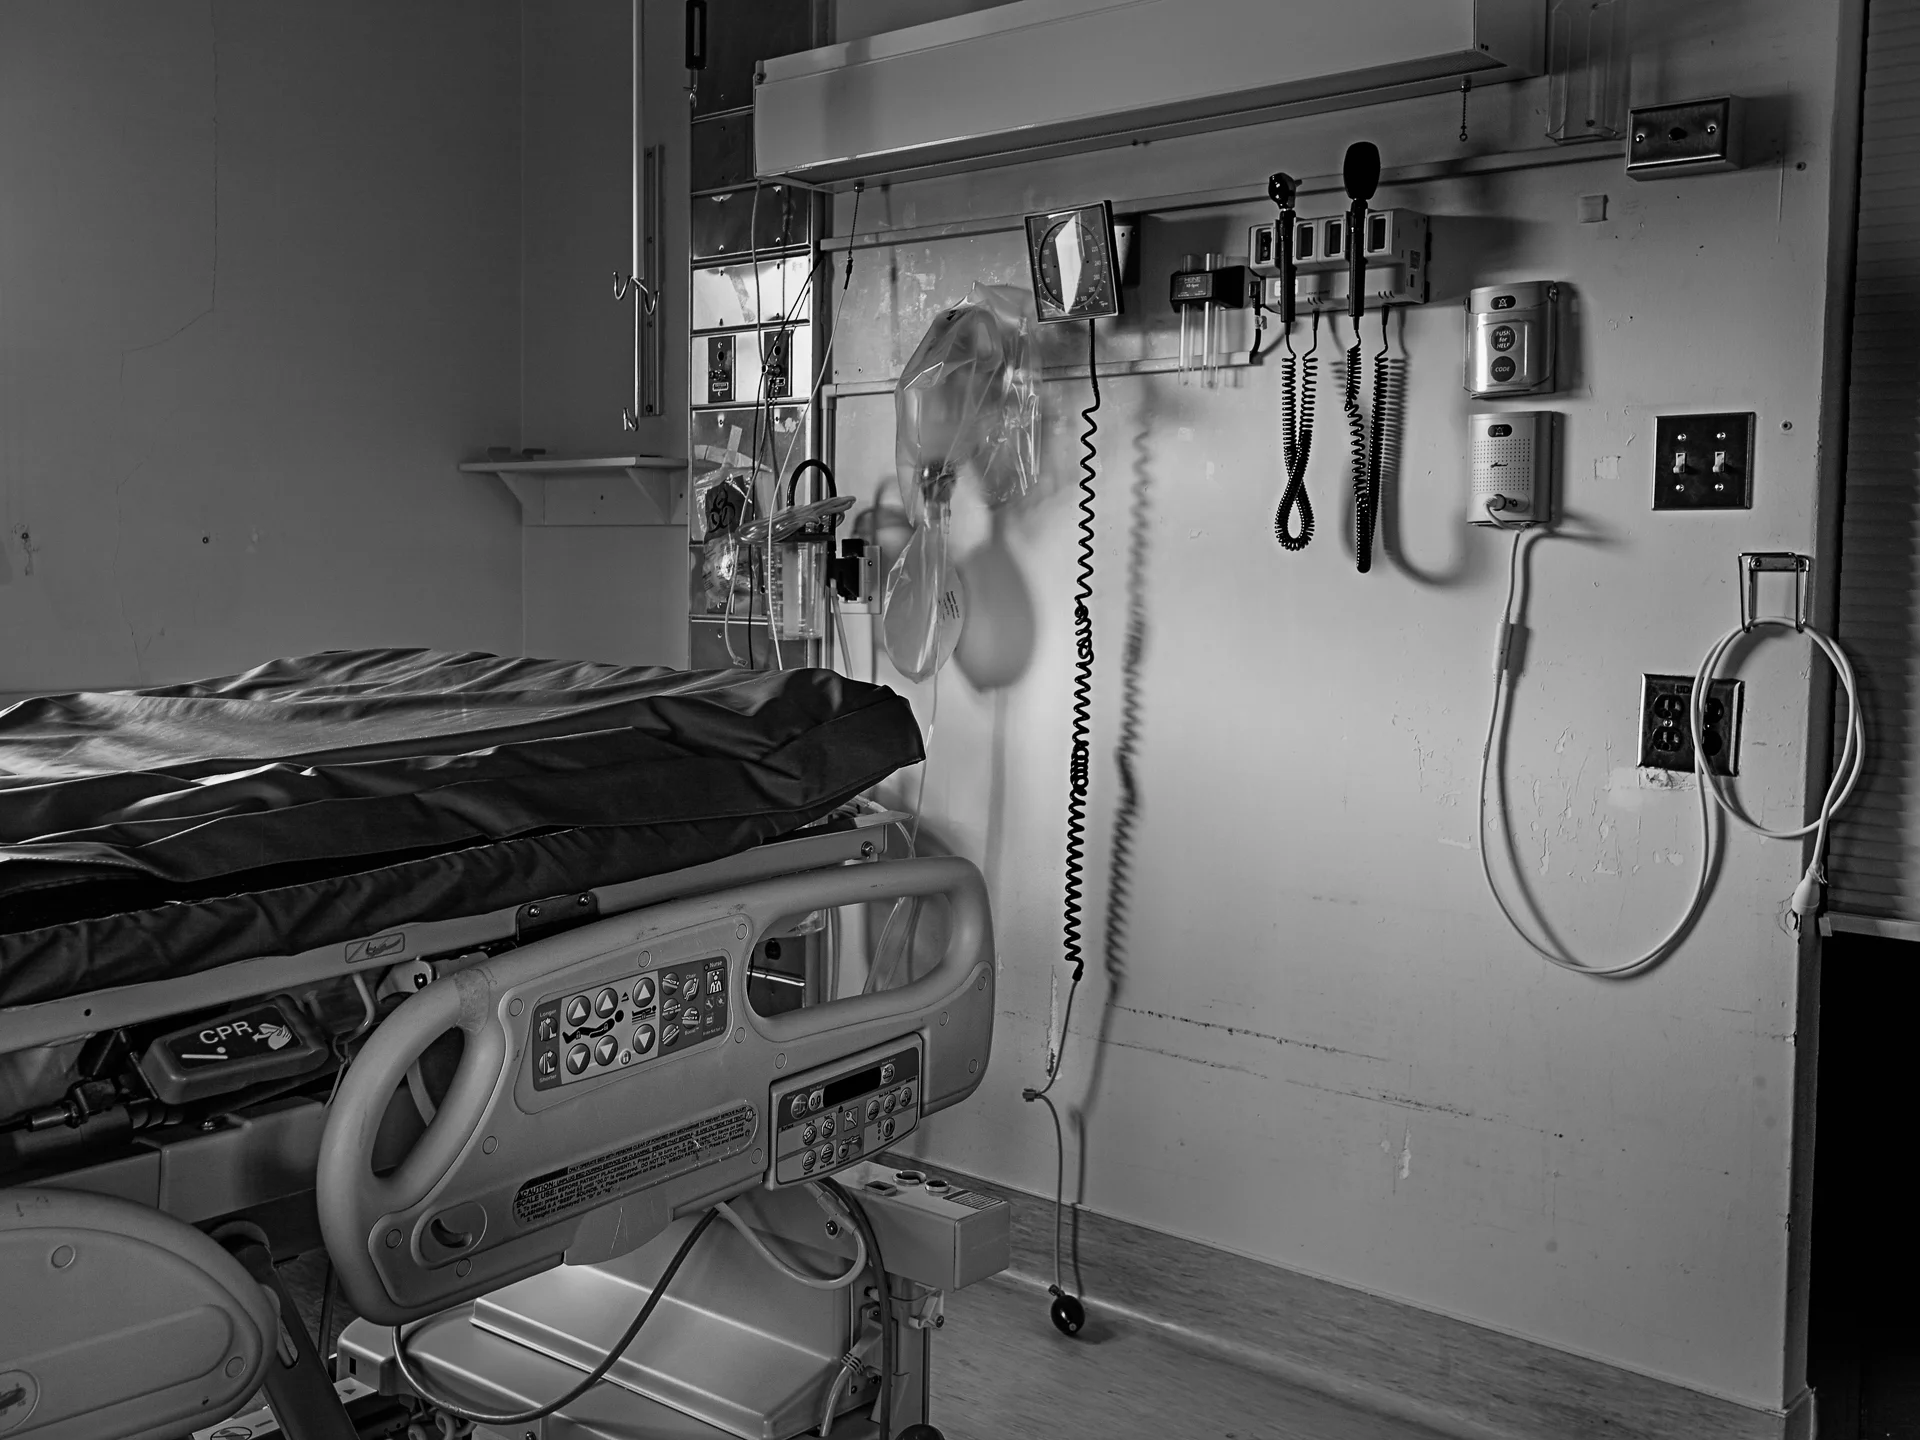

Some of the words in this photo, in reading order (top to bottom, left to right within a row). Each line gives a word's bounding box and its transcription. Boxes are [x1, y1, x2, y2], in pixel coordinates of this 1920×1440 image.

[540, 1009, 556, 1018] Longer
[199, 1021, 252, 1044] CPR
[539, 1074, 557, 1083] Shorter
[810, 1095, 821, 1107] 0.0
[660, 1152, 676, 1160] TOUCH
[516, 1194, 539, 1207] SCALE
[540, 1188, 556, 1199] USE:
[557, 1181, 578, 1192] BEFORE
[579, 1174, 600, 1184] PATIENT
[600, 1162, 630, 1176] PLACEMENT:
[637, 1155, 650, 1163] Press
[522, 1181, 556, 1197] CAUTION:
[585, 1165, 602, 1174] DURING
[602, 1158, 620, 1168] SERVICE
[520, 1205, 546, 1217] FLASHING
[626, 1170, 642, 1179] patient
[532, 1210, 550, 1220] Weight
